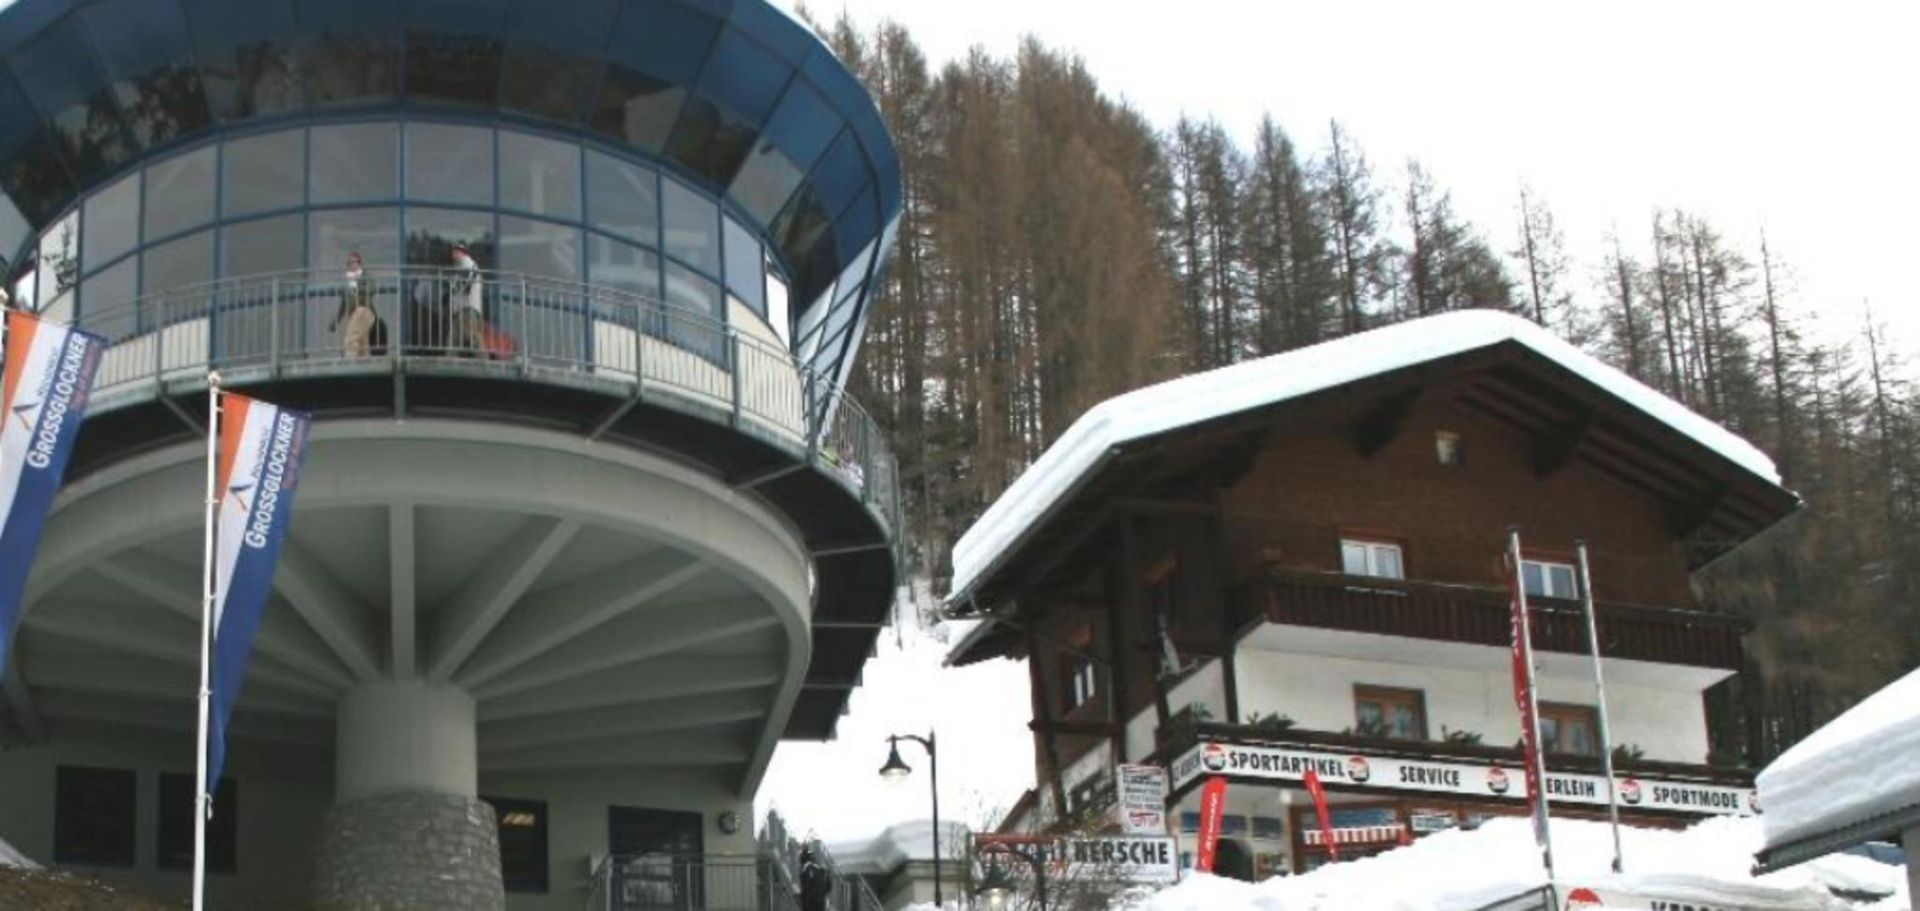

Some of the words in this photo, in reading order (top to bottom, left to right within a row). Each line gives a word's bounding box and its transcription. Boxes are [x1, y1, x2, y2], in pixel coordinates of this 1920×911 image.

[26, 332, 89, 469] GROSSGLOCKNER
[245, 411, 297, 548] GROSSGLOCKNER
[1229, 749, 1346, 777] SPORTARTIKEL
[1399, 765, 1460, 786] SERVICE
[1546, 777, 1596, 798] ERLEIH
[1652, 786, 1740, 809] SPORTMODE
[1073, 841, 1170, 865] KERSCHE
